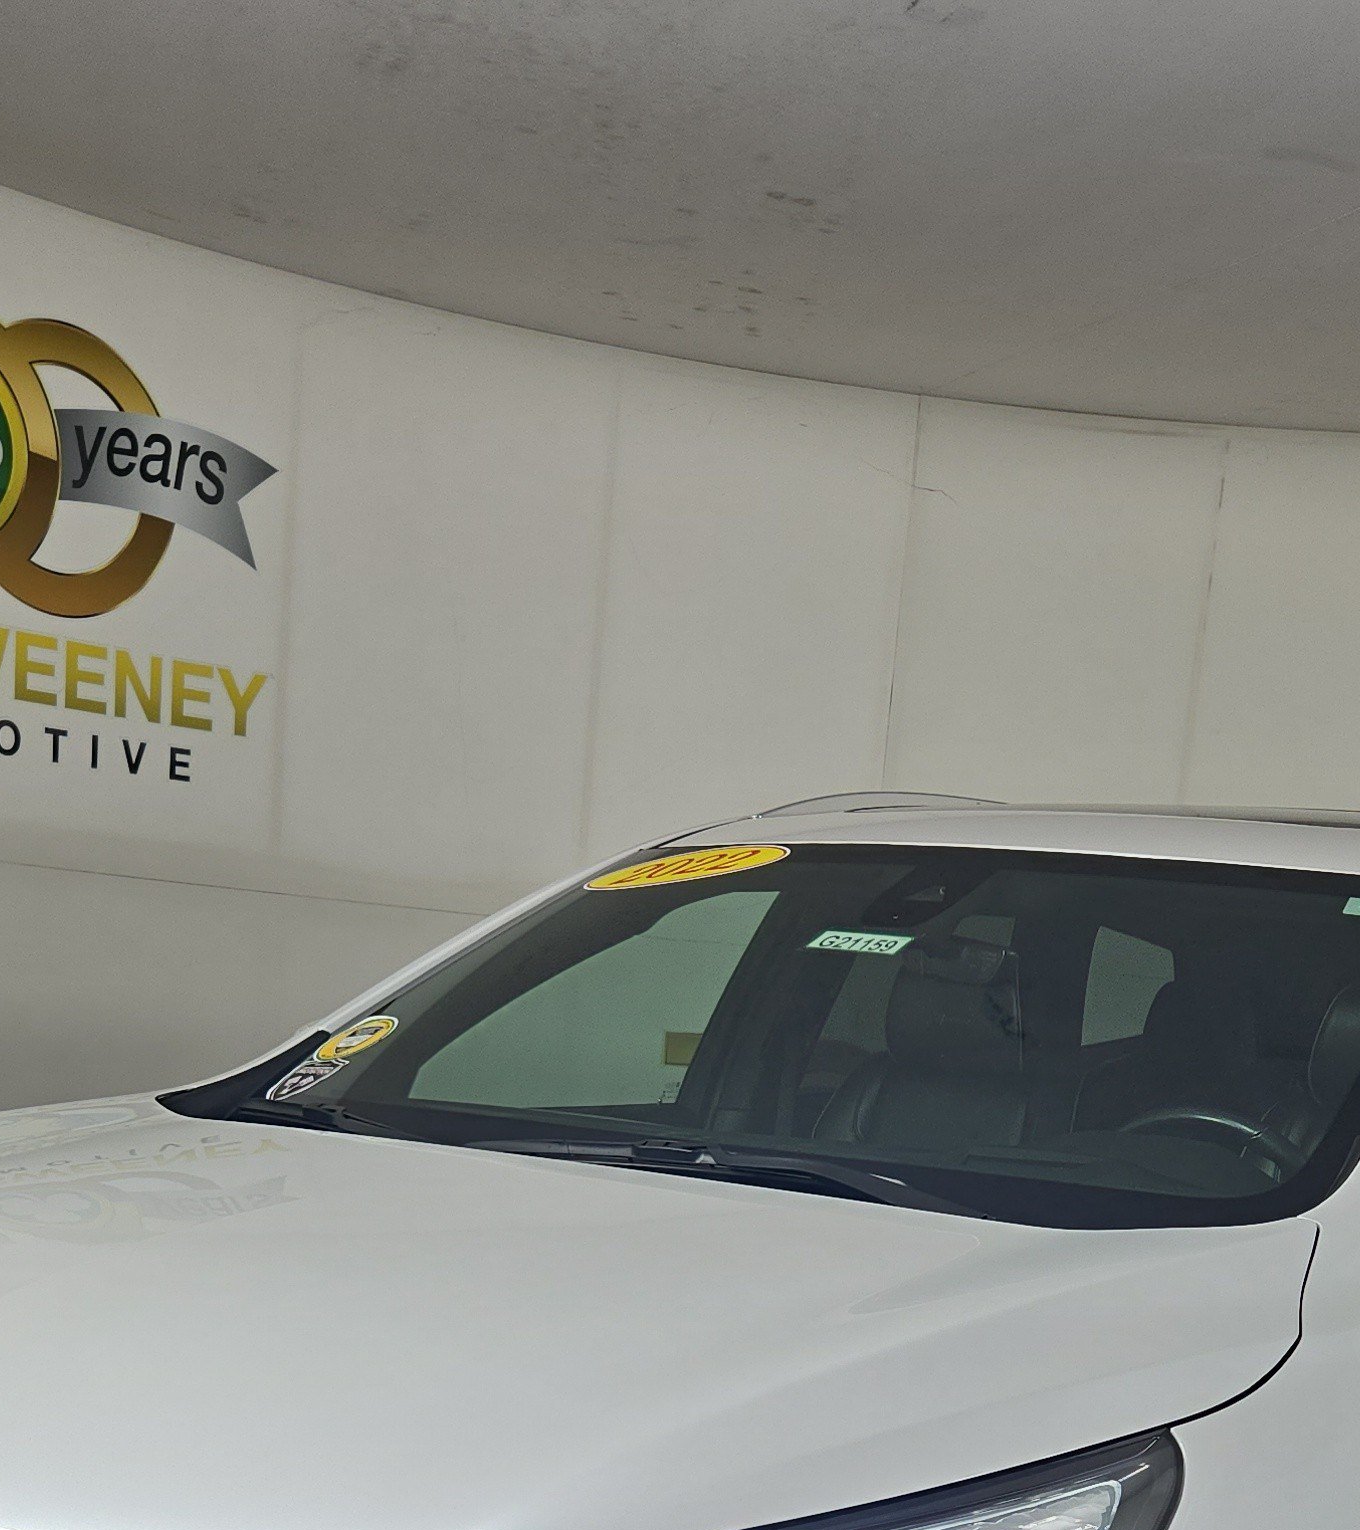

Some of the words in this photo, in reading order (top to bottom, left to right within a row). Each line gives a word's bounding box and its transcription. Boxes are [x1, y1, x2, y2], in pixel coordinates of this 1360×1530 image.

[71, 424, 228, 505] years
[609, 850, 762, 886] 2022
[819, 935, 898, 952] G21159
